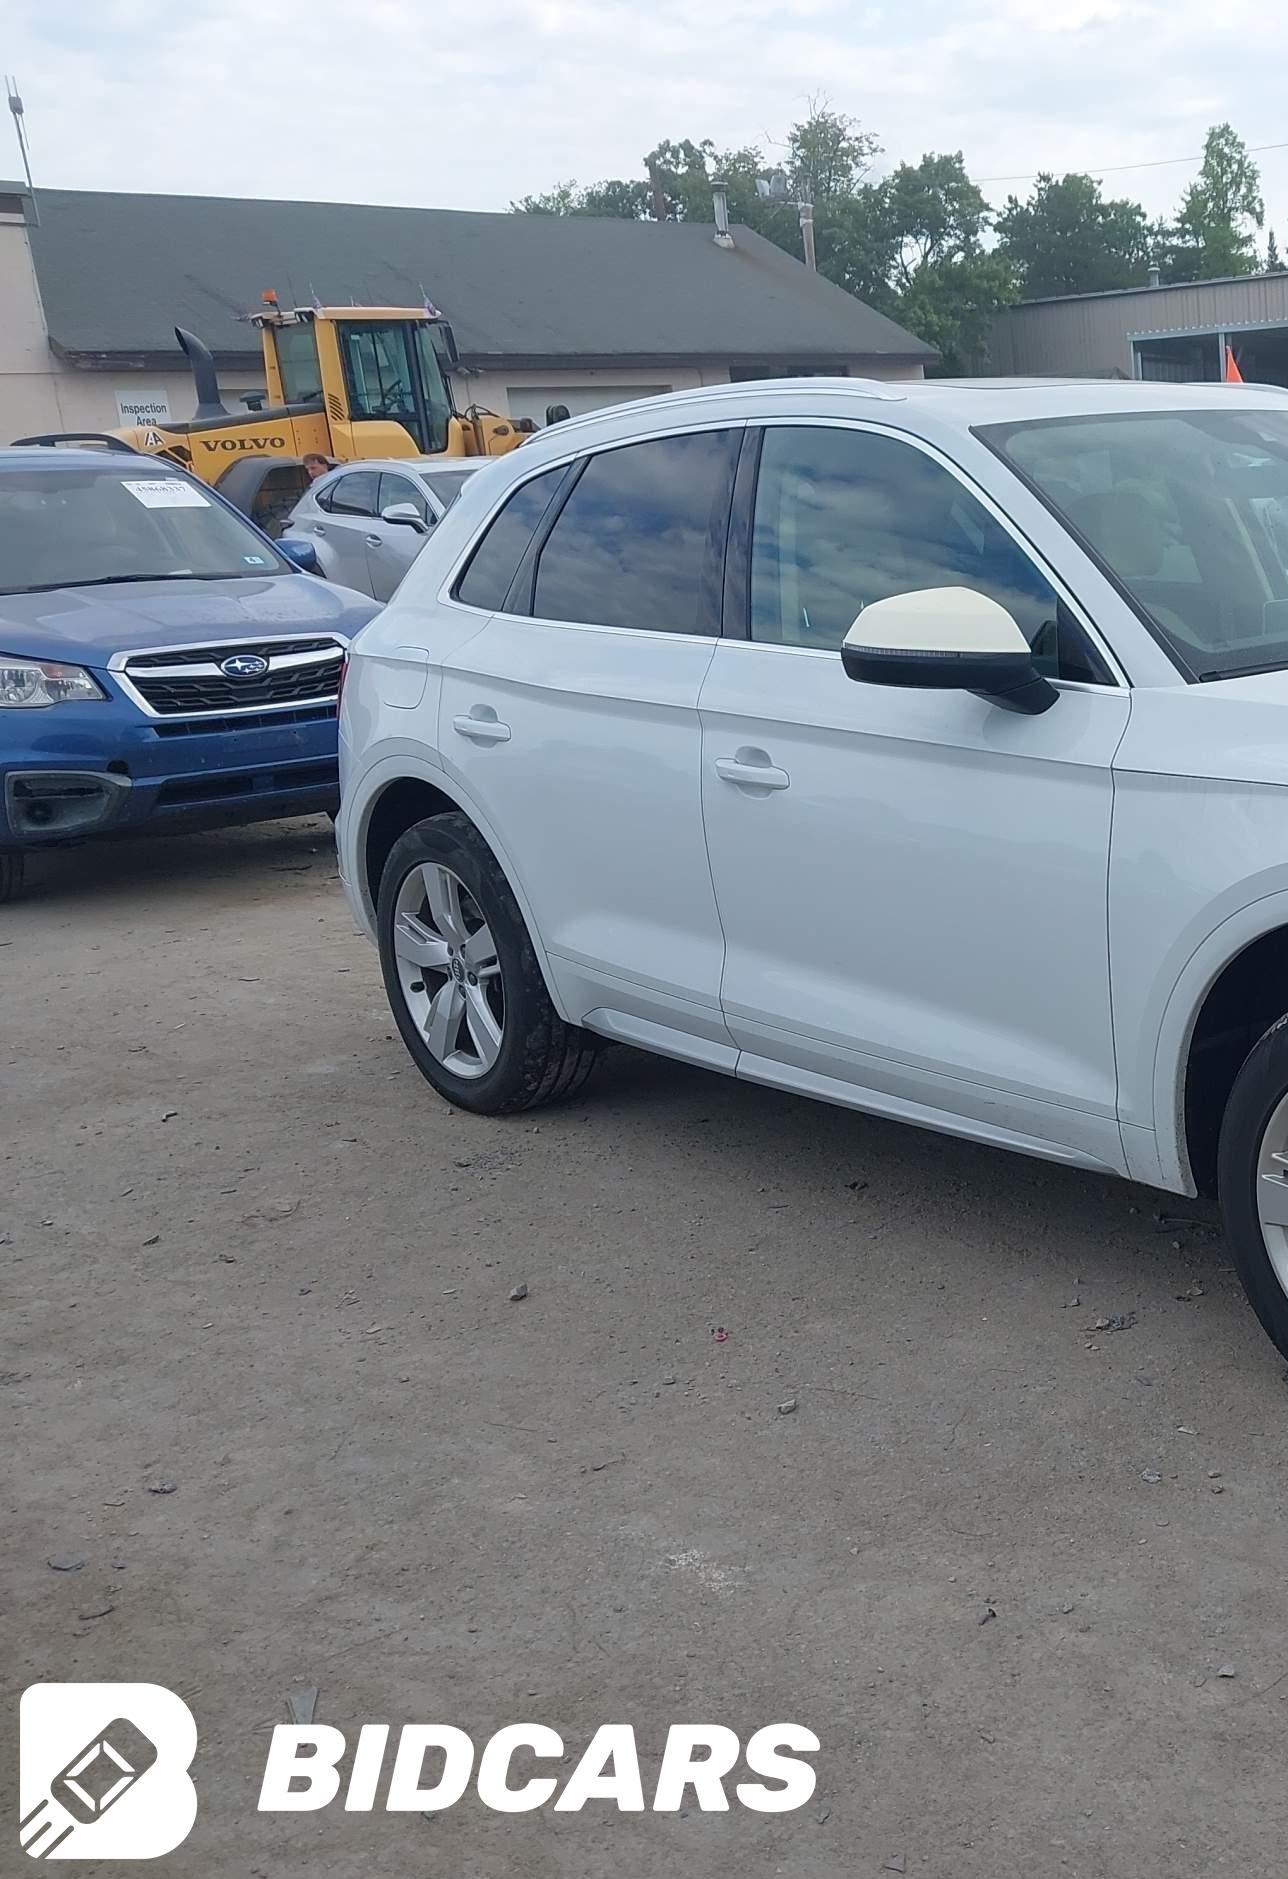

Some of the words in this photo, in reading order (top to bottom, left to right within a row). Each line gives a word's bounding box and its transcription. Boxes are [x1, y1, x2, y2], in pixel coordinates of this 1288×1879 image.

[120, 402, 168, 415] Inspection
[136, 416, 157, 426] Area
[200, 437, 286, 452] VOLVO
